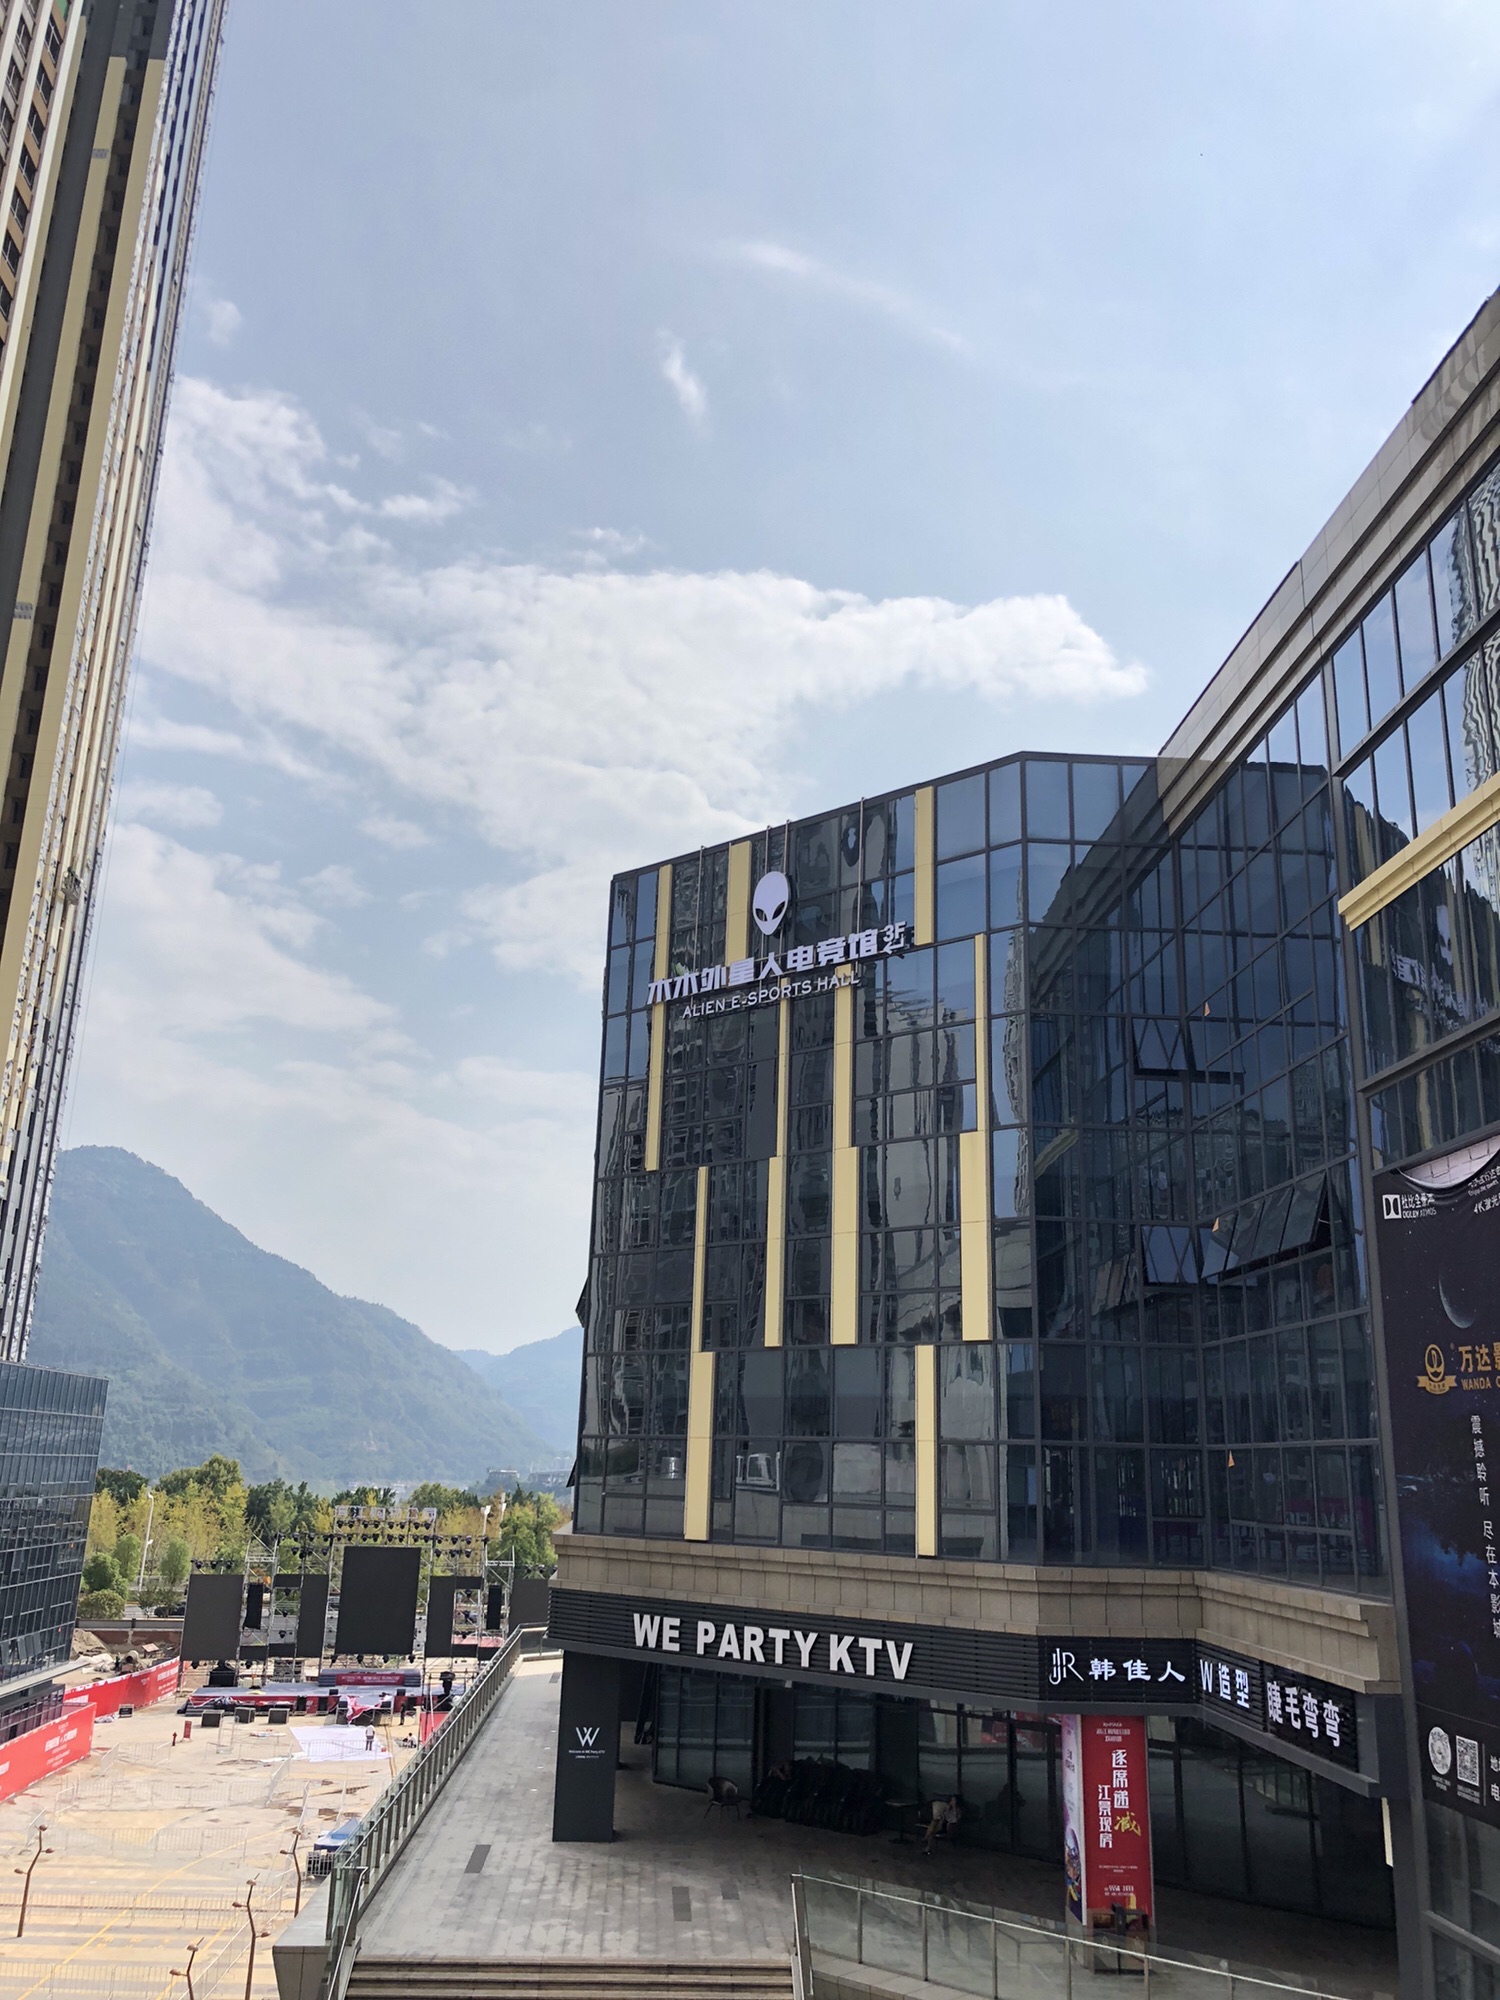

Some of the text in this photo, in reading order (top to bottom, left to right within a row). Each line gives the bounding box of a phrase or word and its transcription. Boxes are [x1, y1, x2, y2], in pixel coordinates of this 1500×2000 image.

[883, 921, 907, 942] 3F
[682, 971, 860, 1019] ALIEN E-SPORTS HALL
[1461, 1377, 1492, 1390] WANDA
[633, 1613, 914, 1680] WE PARTY KTV
[1088, 1657, 1186, 1682] 韩佳人
[1266, 1680, 1341, 1748] 睫毛弯弯
[1097, 1784, 1113, 1849] 江景现房
